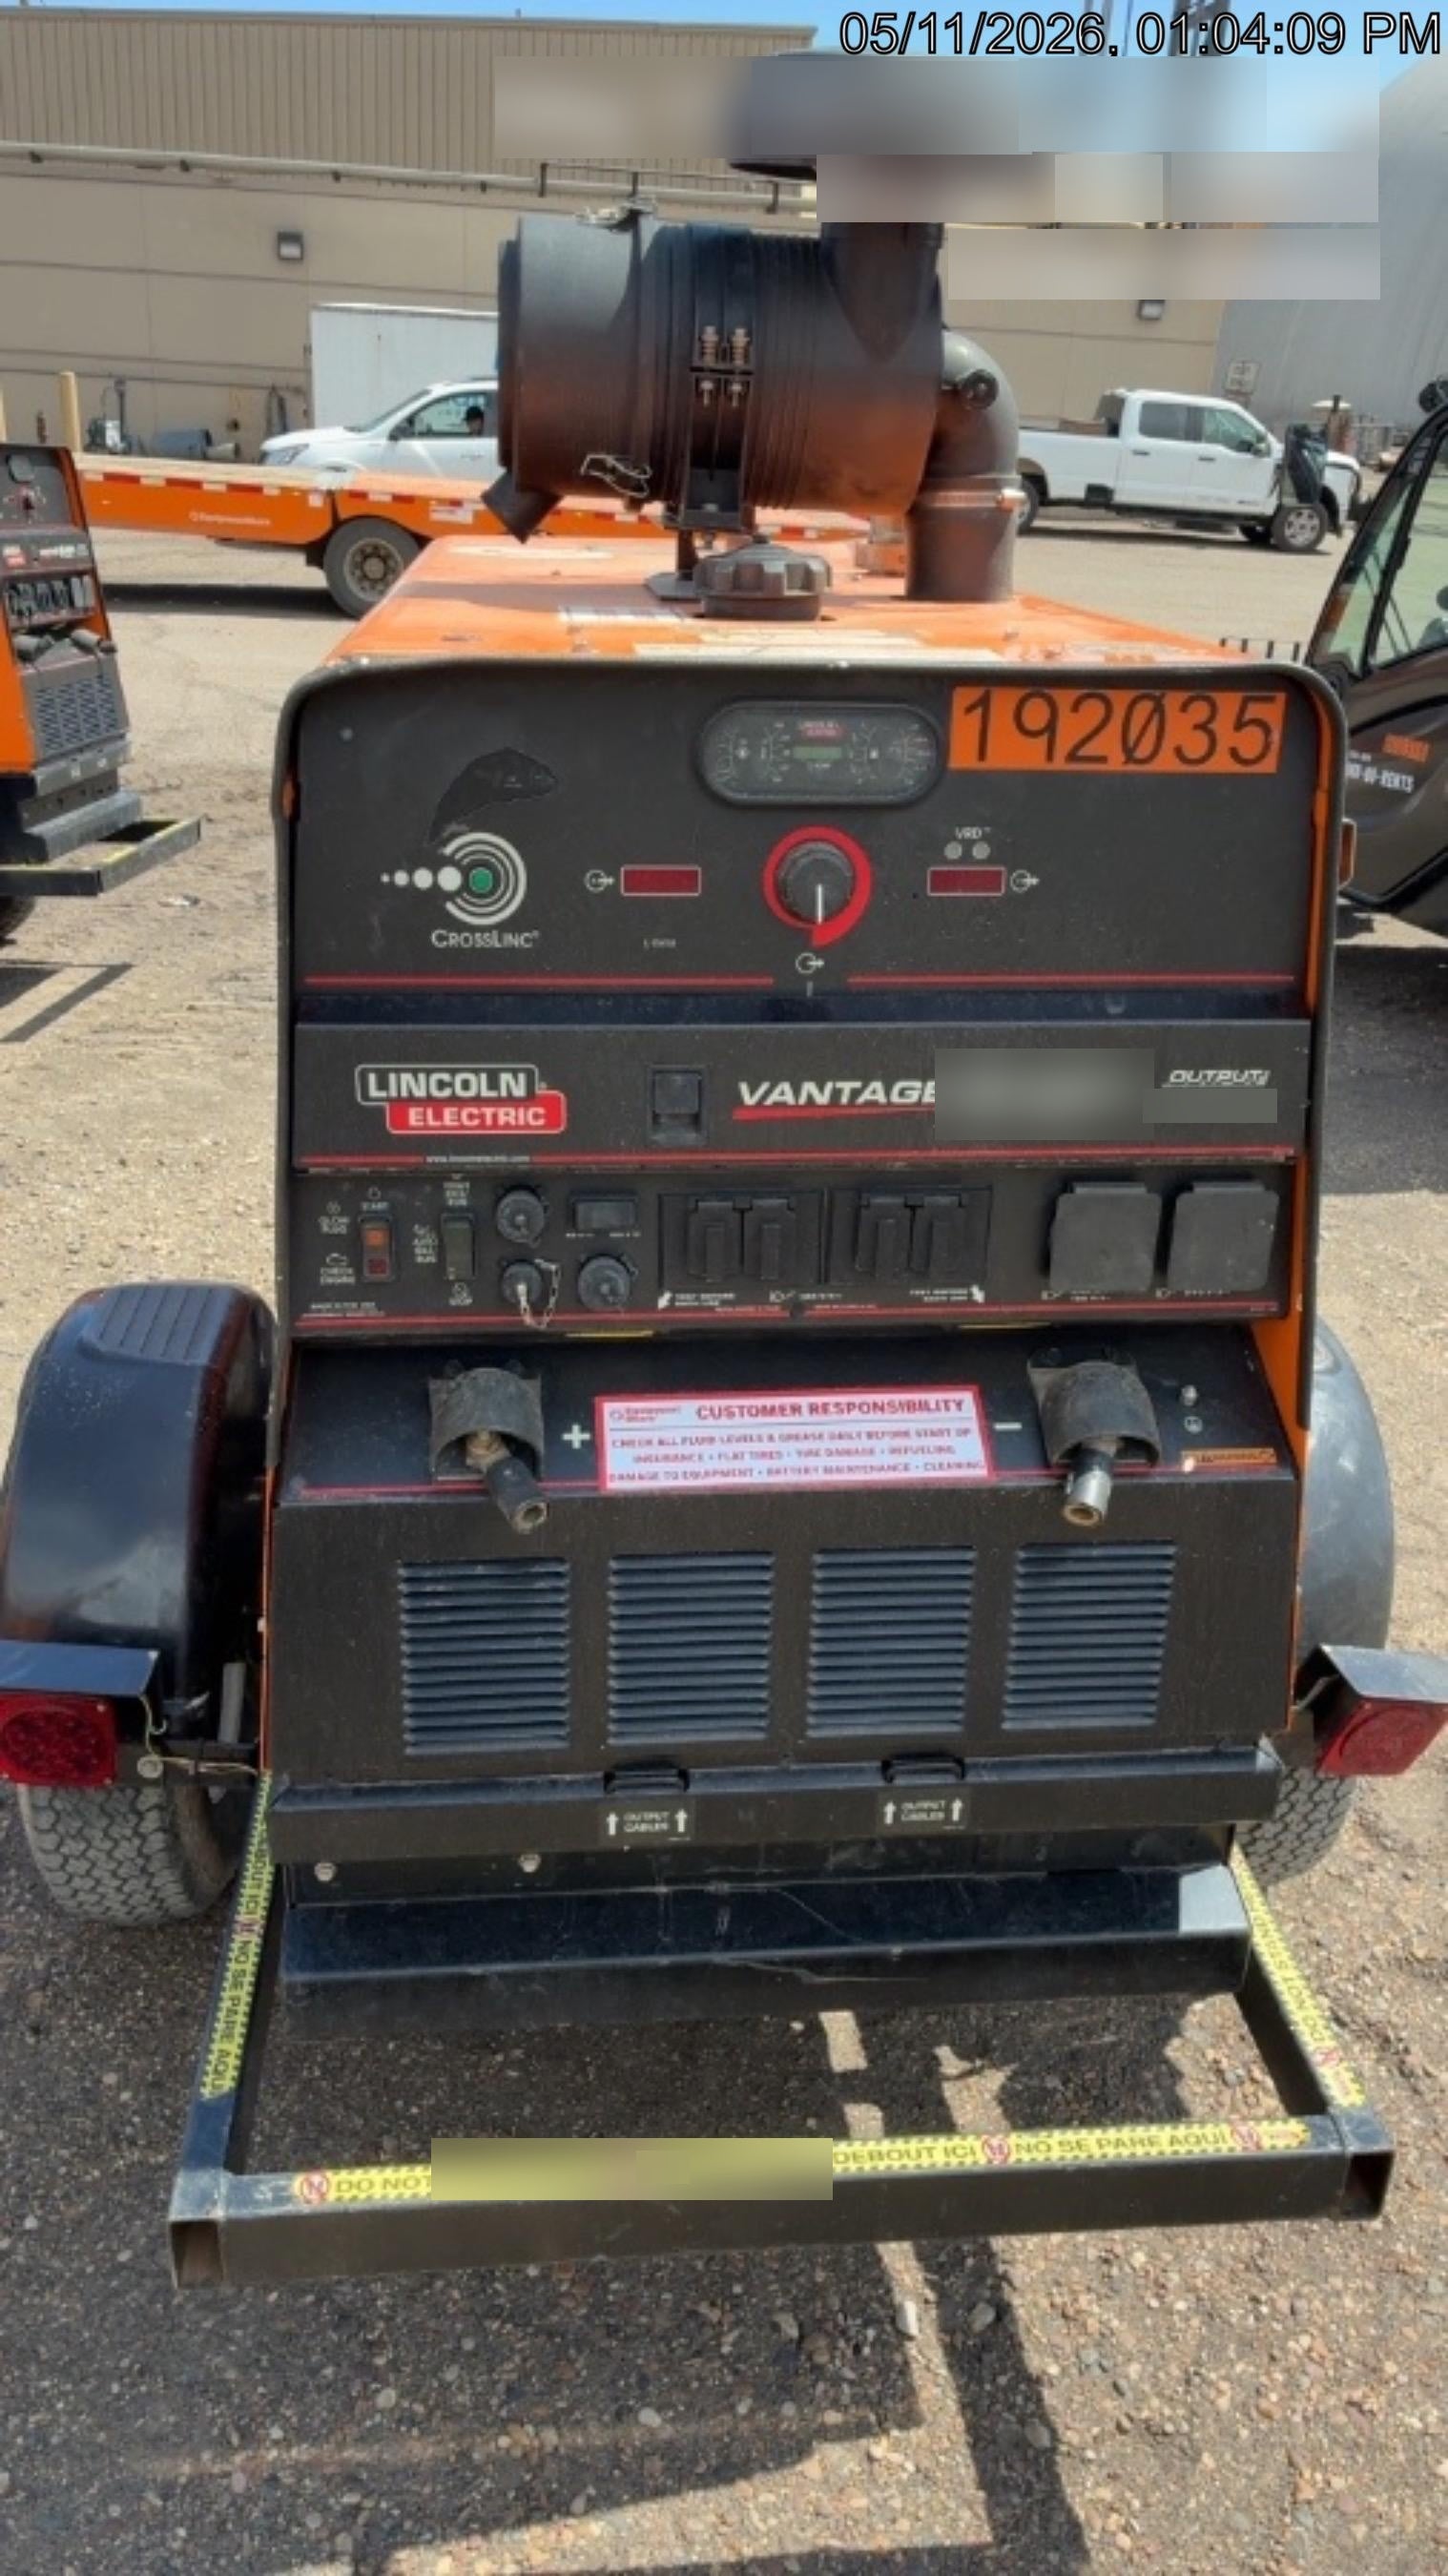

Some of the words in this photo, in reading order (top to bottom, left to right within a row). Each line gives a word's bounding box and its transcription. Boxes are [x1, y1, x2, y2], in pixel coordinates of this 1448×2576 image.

[963, 689, 1275, 767] 192035
[367, 1071, 527, 1098] LINCOLN
[407, 1107, 546, 1127] ELECTRIC
[696, 1403, 802, 1420] CUSTOMER
[809, 1399, 964, 1416] RESPONSIBILITY
[336, 2177, 375, 2193] DO
[834, 2146, 937, 2165] DEBOUT
[943, 2145, 977, 2159] ICI
[1015, 2141, 1050, 2155] NO
[1058, 2140, 1089, 2153] SE
[1096, 2137, 1160, 2150] PARE
